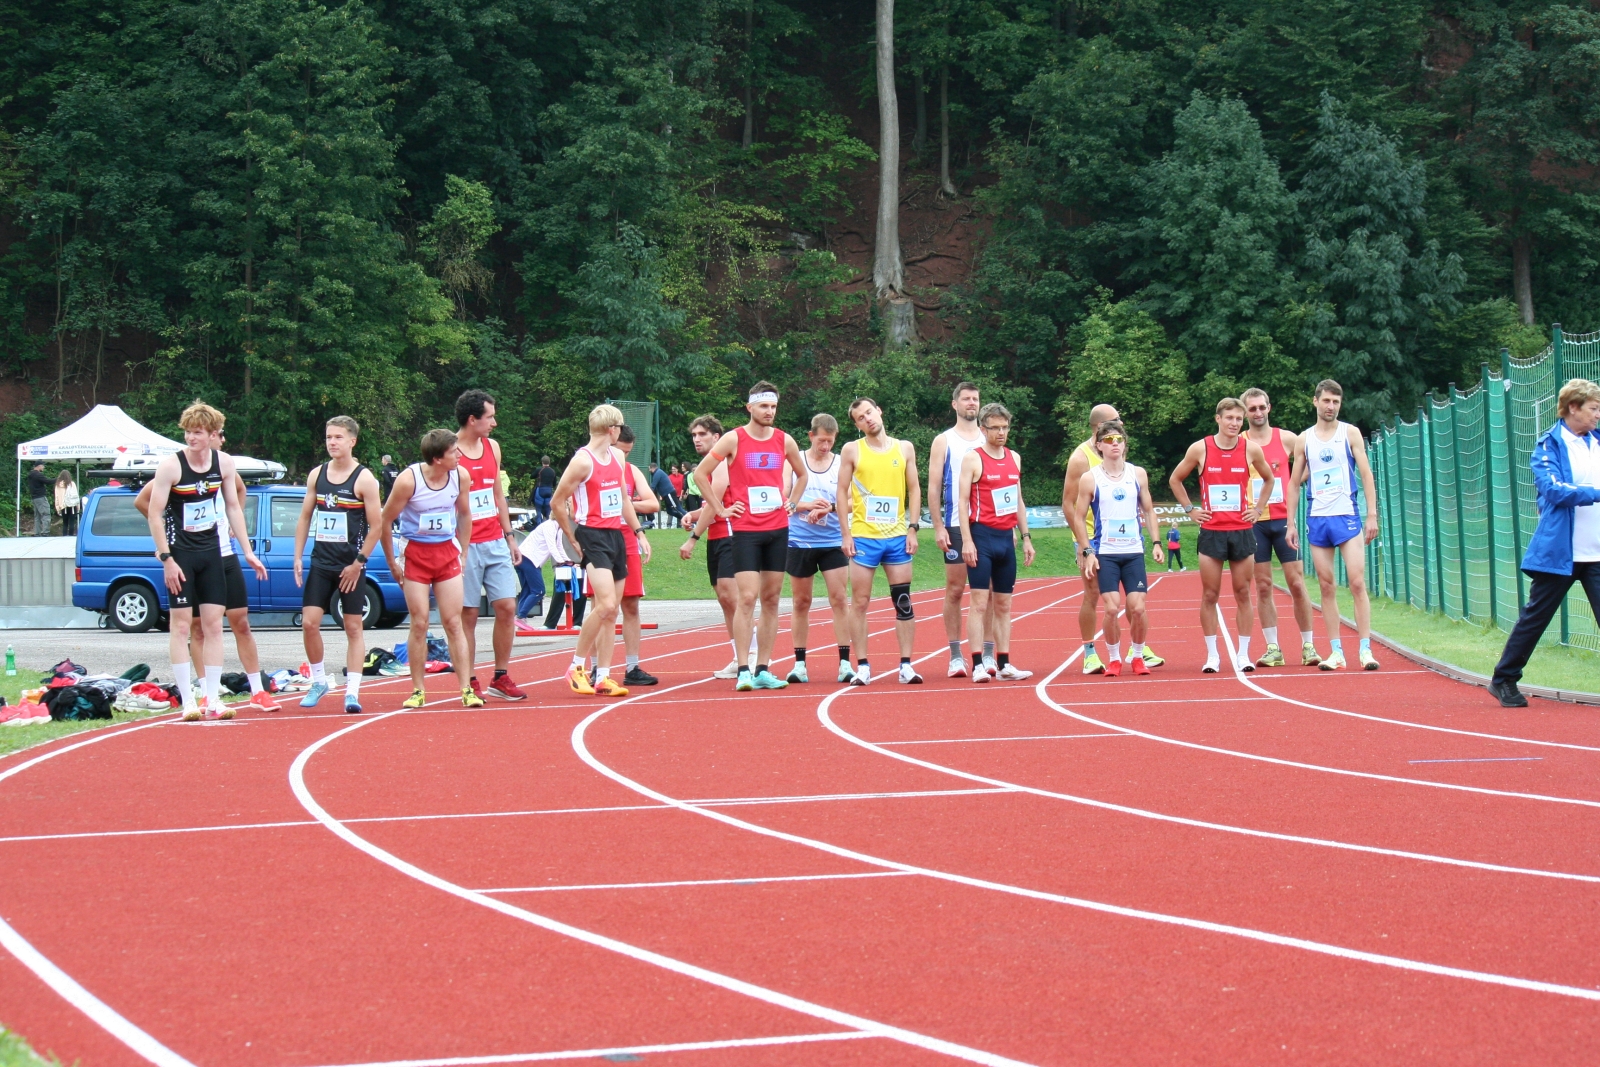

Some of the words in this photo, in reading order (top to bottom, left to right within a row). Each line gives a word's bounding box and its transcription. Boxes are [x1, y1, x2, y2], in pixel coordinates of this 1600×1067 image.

[1324, 474, 1331, 485] 2
[474, 494, 489, 508] 14
[608, 494, 618, 506] 13
[760, 492, 768, 502] 9
[1004, 492, 1010, 504] 6
[1221, 490, 1228, 502] 3
[194, 506, 206, 520] 22
[875, 502, 890, 513] 20
[323, 518, 337, 530] 17
[428, 518, 442, 530] 15
[1118, 524, 1126, 534] 4
